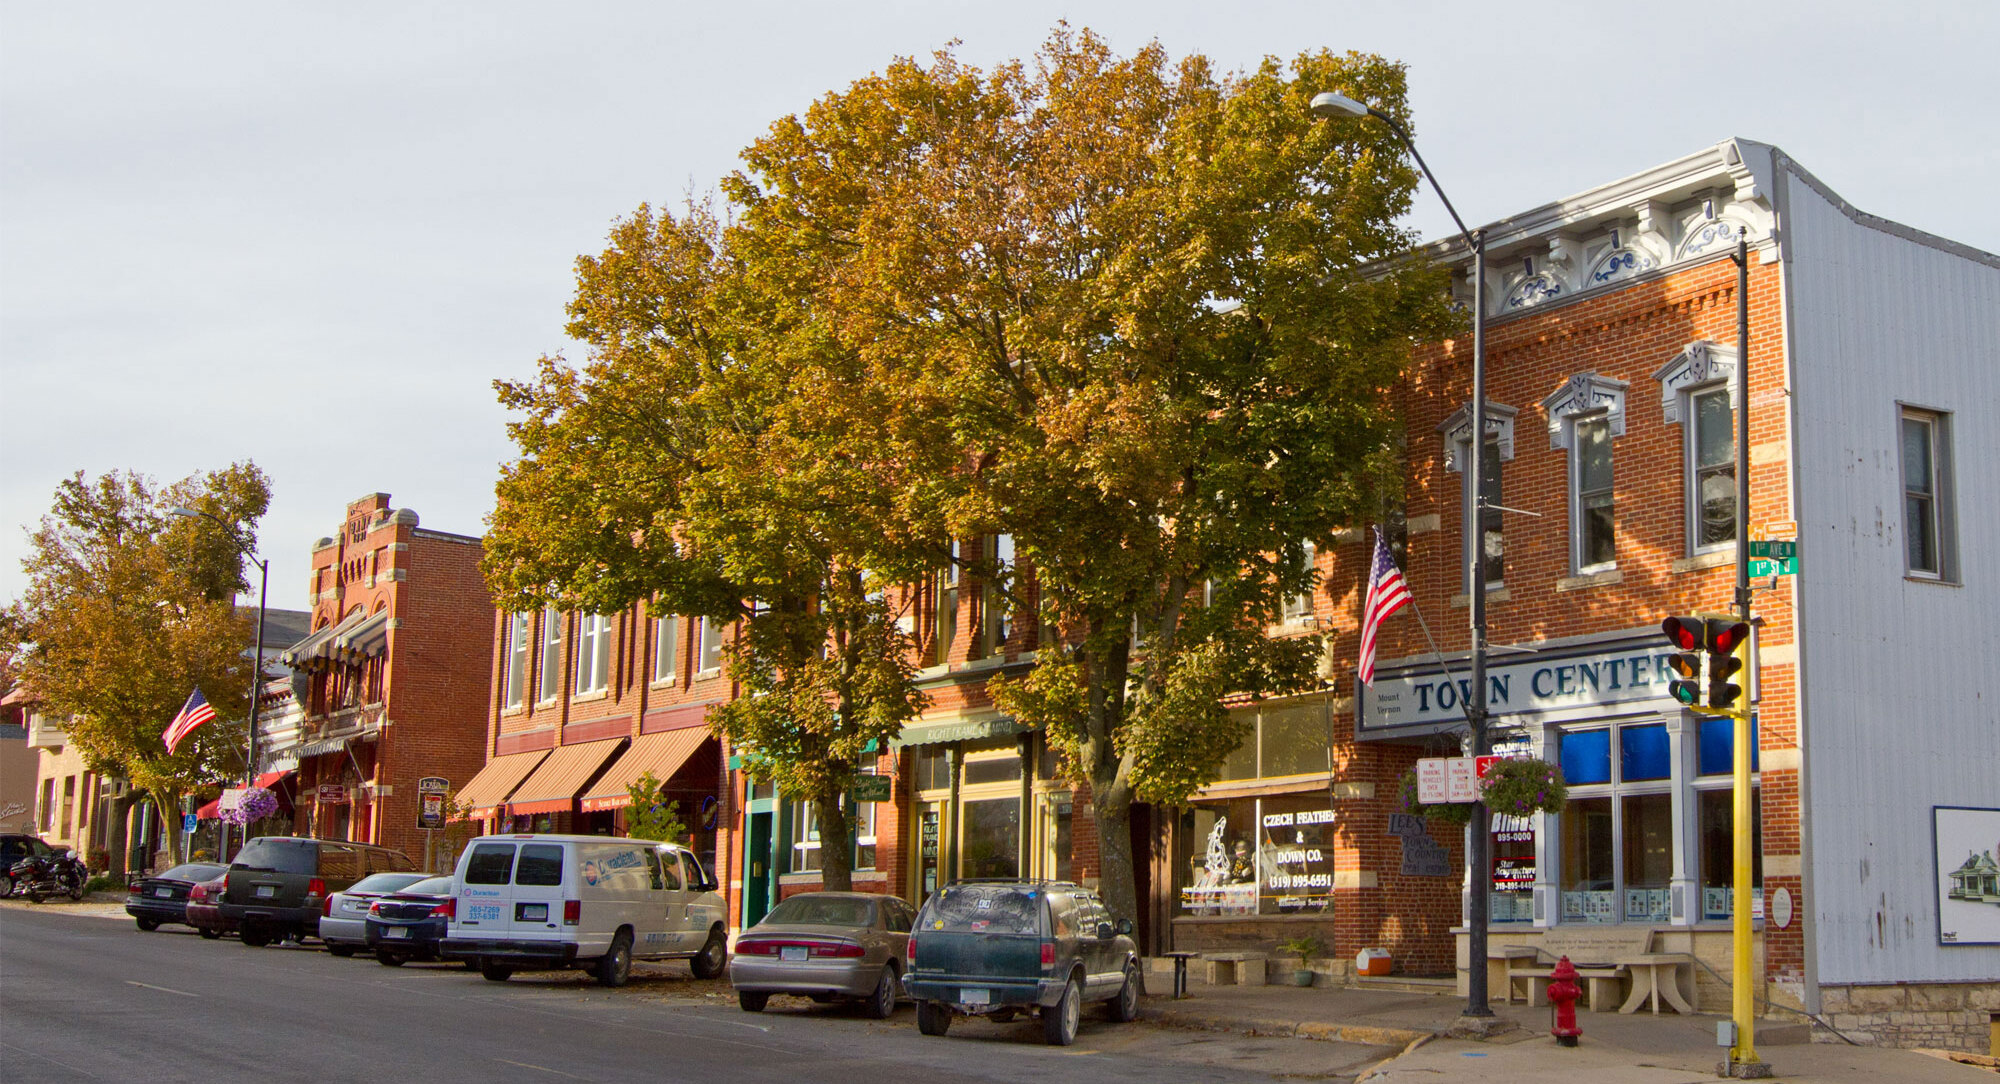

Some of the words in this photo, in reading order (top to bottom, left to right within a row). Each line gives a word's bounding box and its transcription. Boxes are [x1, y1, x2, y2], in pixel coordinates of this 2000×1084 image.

[1532, 653, 1677, 698] CENTER
[1378, 694, 1400, 702] Mount
[1377, 706, 1401, 715] Vernon
[927, 727, 949, 740] RIGHT
[951, 724, 978, 738] FRAME
[979, 722, 991, 735] OF
[992, 721, 1012, 734] MIND
[1263, 813, 1294, 828] CZECH
[1296, 831, 1304, 843] &
[1497, 832, 1532, 842] 895-0000
[598, 851, 637, 875] Draclean
[1277, 850, 1306, 864] DOWN
[1307, 849, 1323, 862] CO.
[1500, 860, 1514, 868] Star
[1270, 875, 1291, 889] (319)
[1292, 874, 1331, 888] 895-6551
